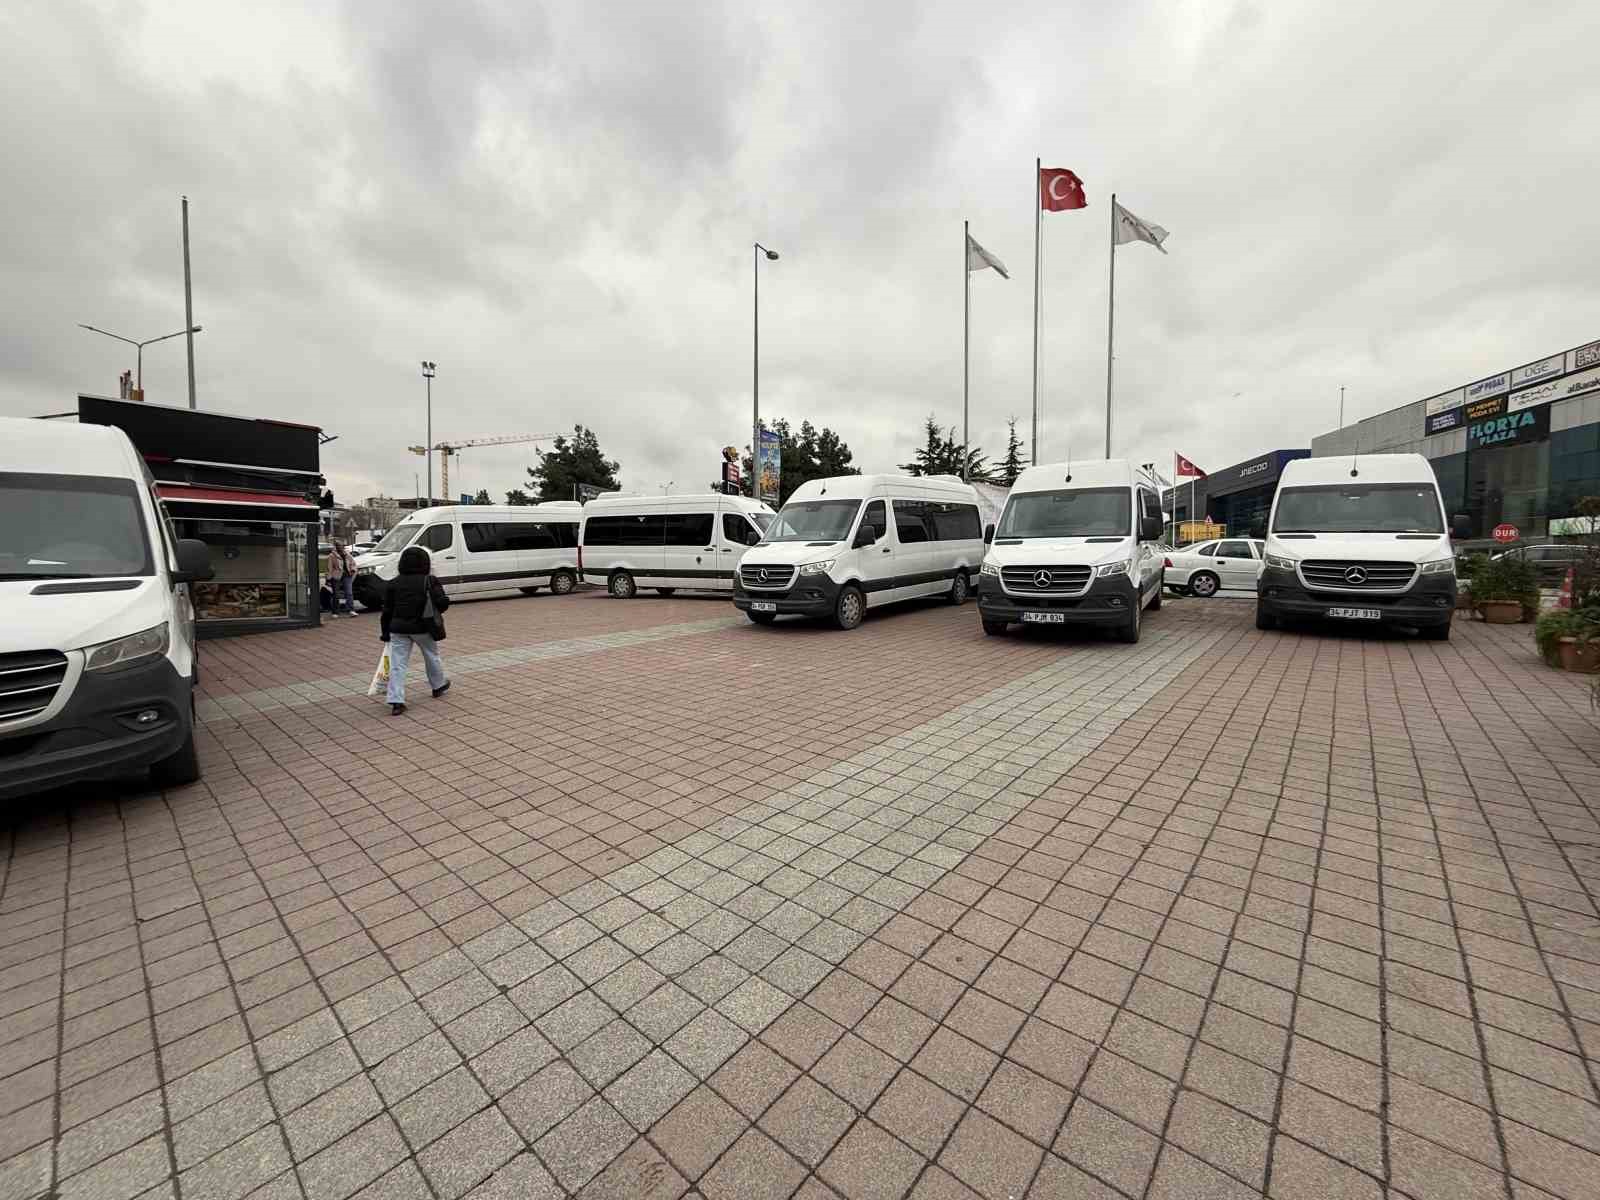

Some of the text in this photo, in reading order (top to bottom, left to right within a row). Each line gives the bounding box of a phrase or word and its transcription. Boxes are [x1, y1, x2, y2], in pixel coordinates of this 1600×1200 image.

[1470, 411, 1536, 440] FLORYA
[1480, 429, 1518, 446] PLAZA
[1495, 529, 1516, 537] DUR
